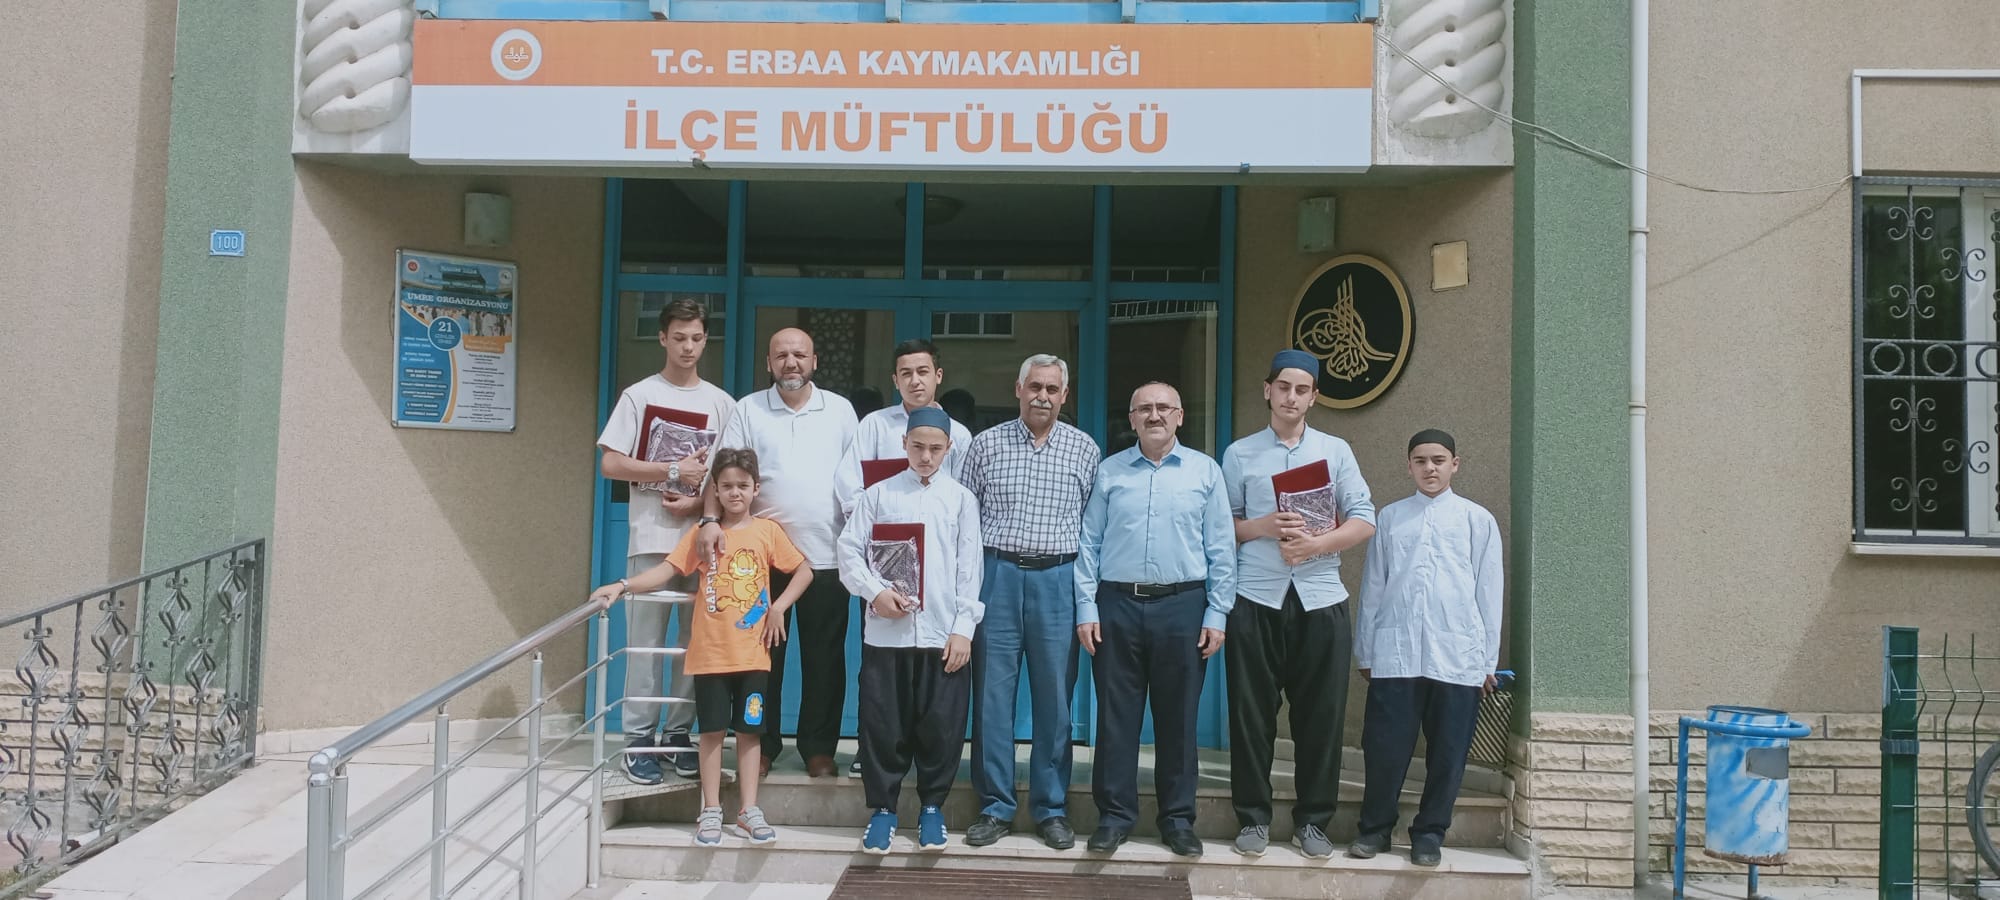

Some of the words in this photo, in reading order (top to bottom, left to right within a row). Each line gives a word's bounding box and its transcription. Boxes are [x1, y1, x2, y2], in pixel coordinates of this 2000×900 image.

[651, 49, 714, 75] T.C.
[726, 49, 847, 75] ERBAA
[858, 45, 1140, 76] KAYMAKAMLIĞI
[625, 100, 759, 161] İLÇE
[782, 102, 1168, 153] MÜFTÜLÜĞÜ
[218, 236, 238, 249] 100
[407, 292, 434, 303] UMRE
[436, 295, 510, 310] ORGANİZASYONU
[438, 321, 453, 332] 21
